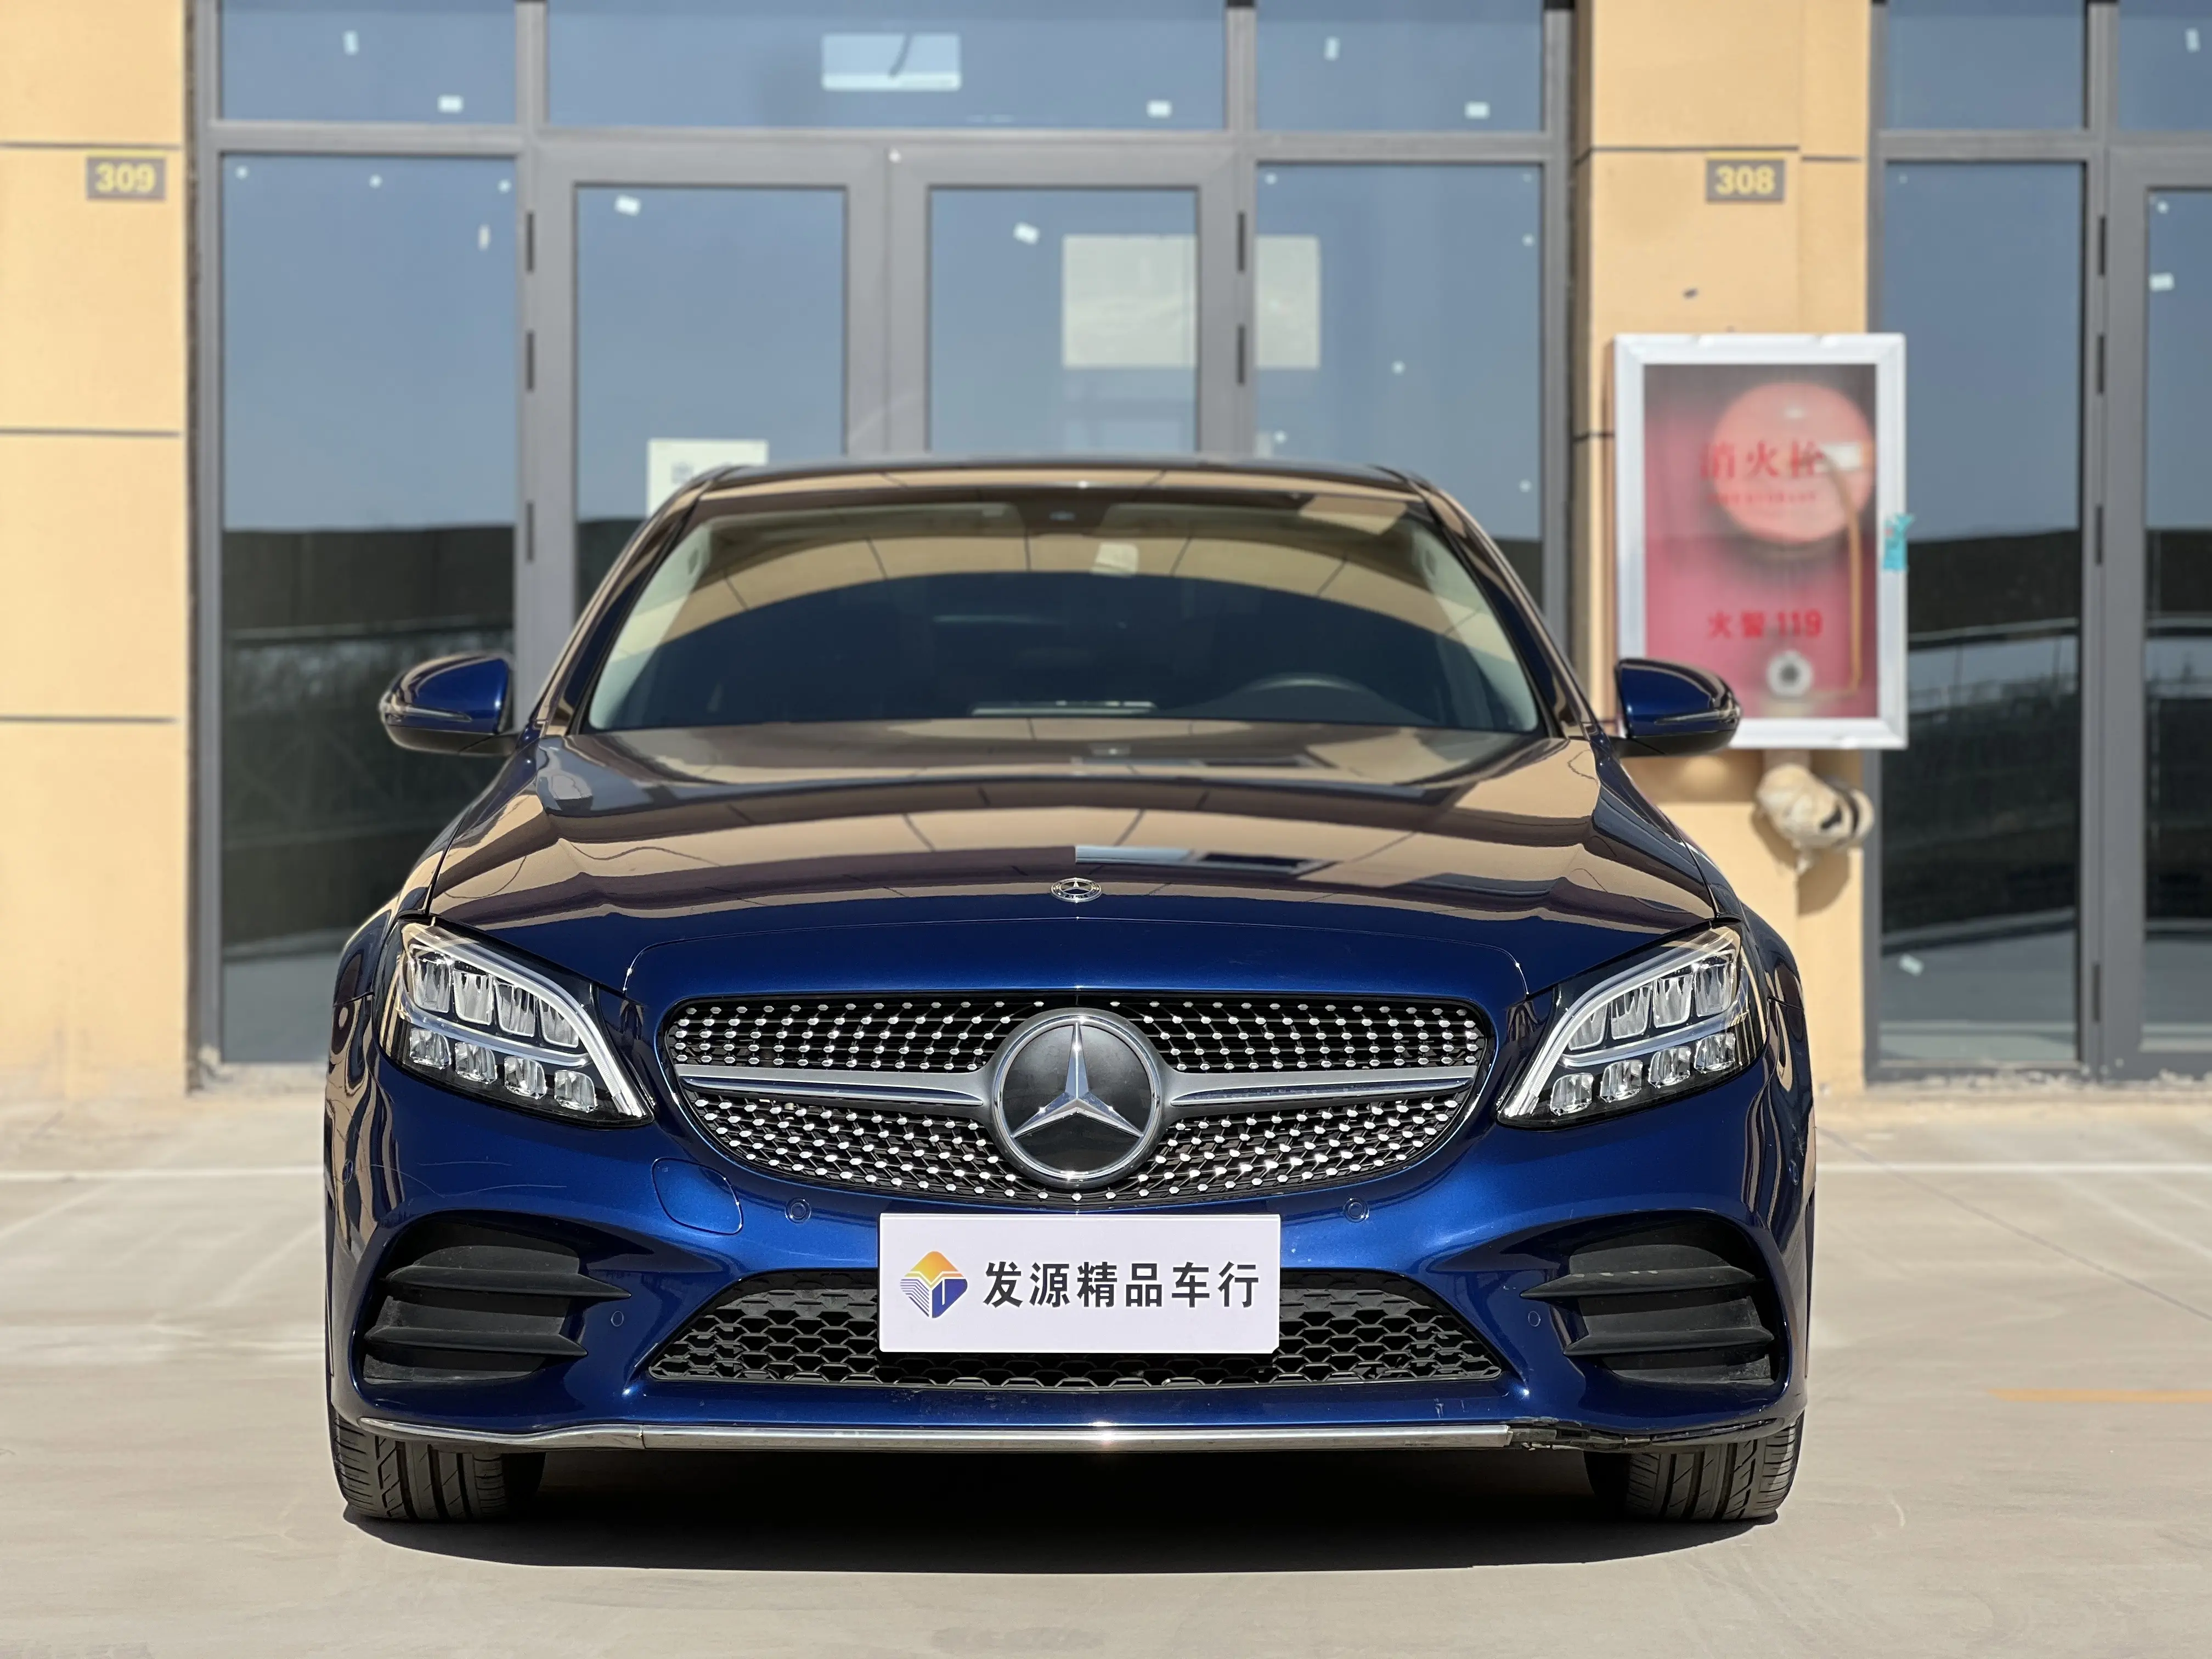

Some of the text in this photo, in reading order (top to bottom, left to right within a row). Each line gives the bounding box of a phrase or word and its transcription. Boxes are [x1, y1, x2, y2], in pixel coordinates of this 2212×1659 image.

[95, 162, 157, 194] 309
[1714, 165, 1776, 196] 308
[1777, 608, 1823, 639] 119
[982, 1261, 1259, 1308] 发源精品车行
